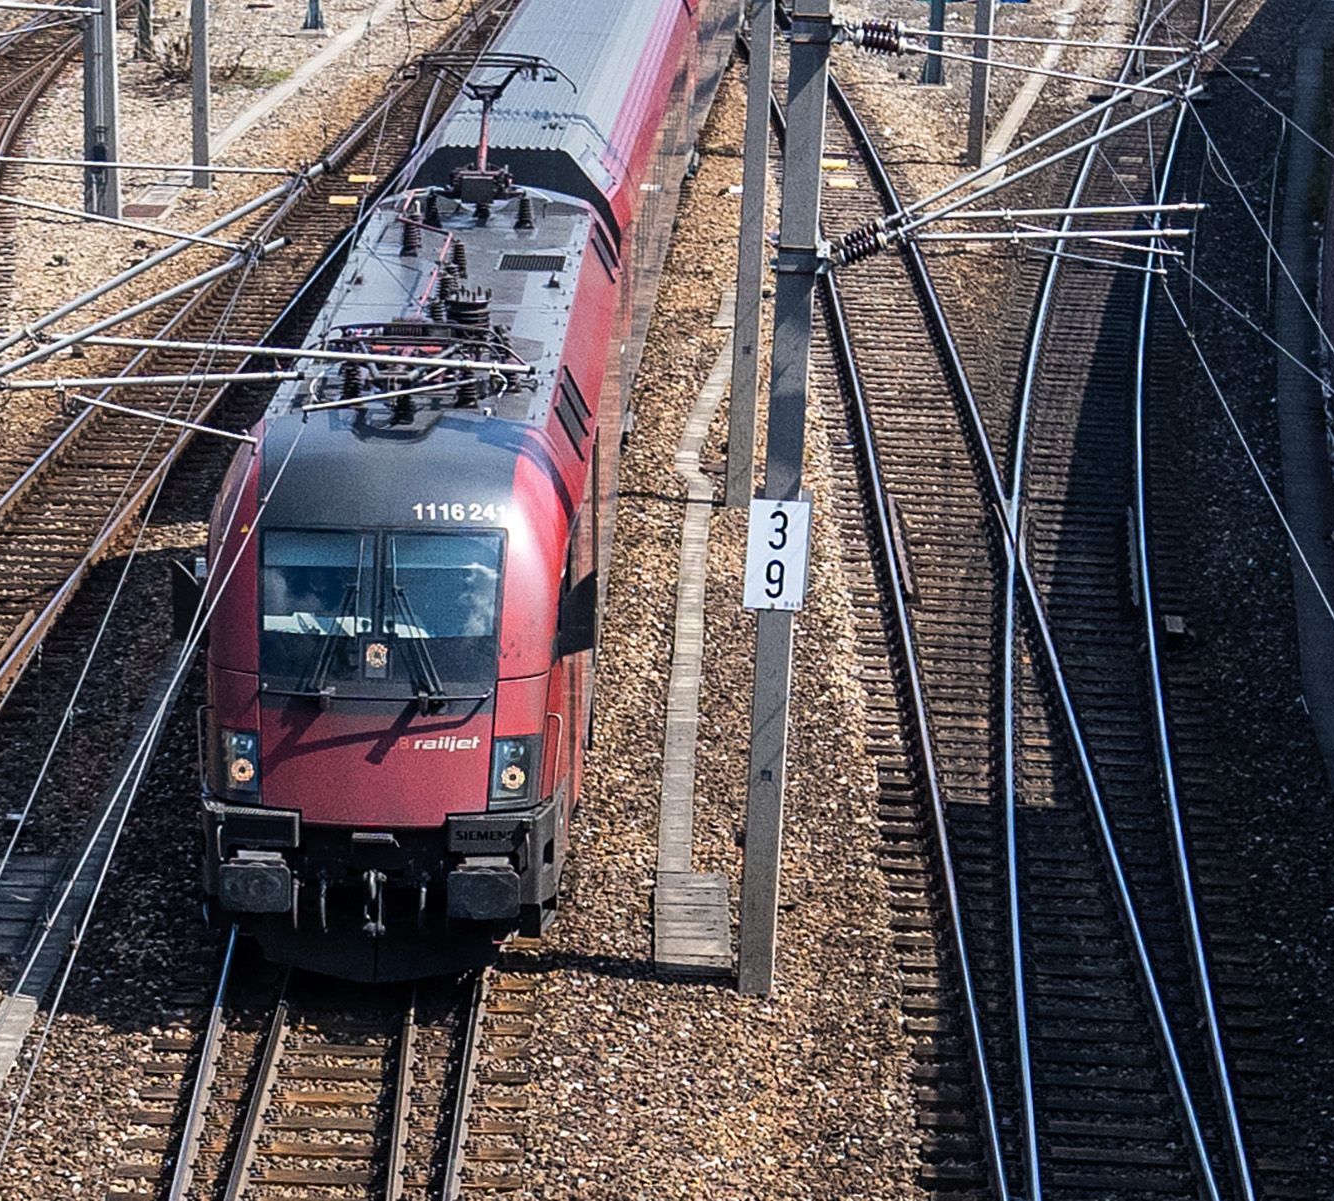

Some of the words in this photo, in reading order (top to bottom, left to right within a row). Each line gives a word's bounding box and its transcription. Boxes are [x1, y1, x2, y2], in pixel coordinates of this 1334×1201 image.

[412, 503, 465, 521] 1116
[768, 510, 788, 550] 3
[765, 559, 785, 599] 9
[413, 736, 480, 752] railjet
[455, 829, 515, 841] SIEMENS
